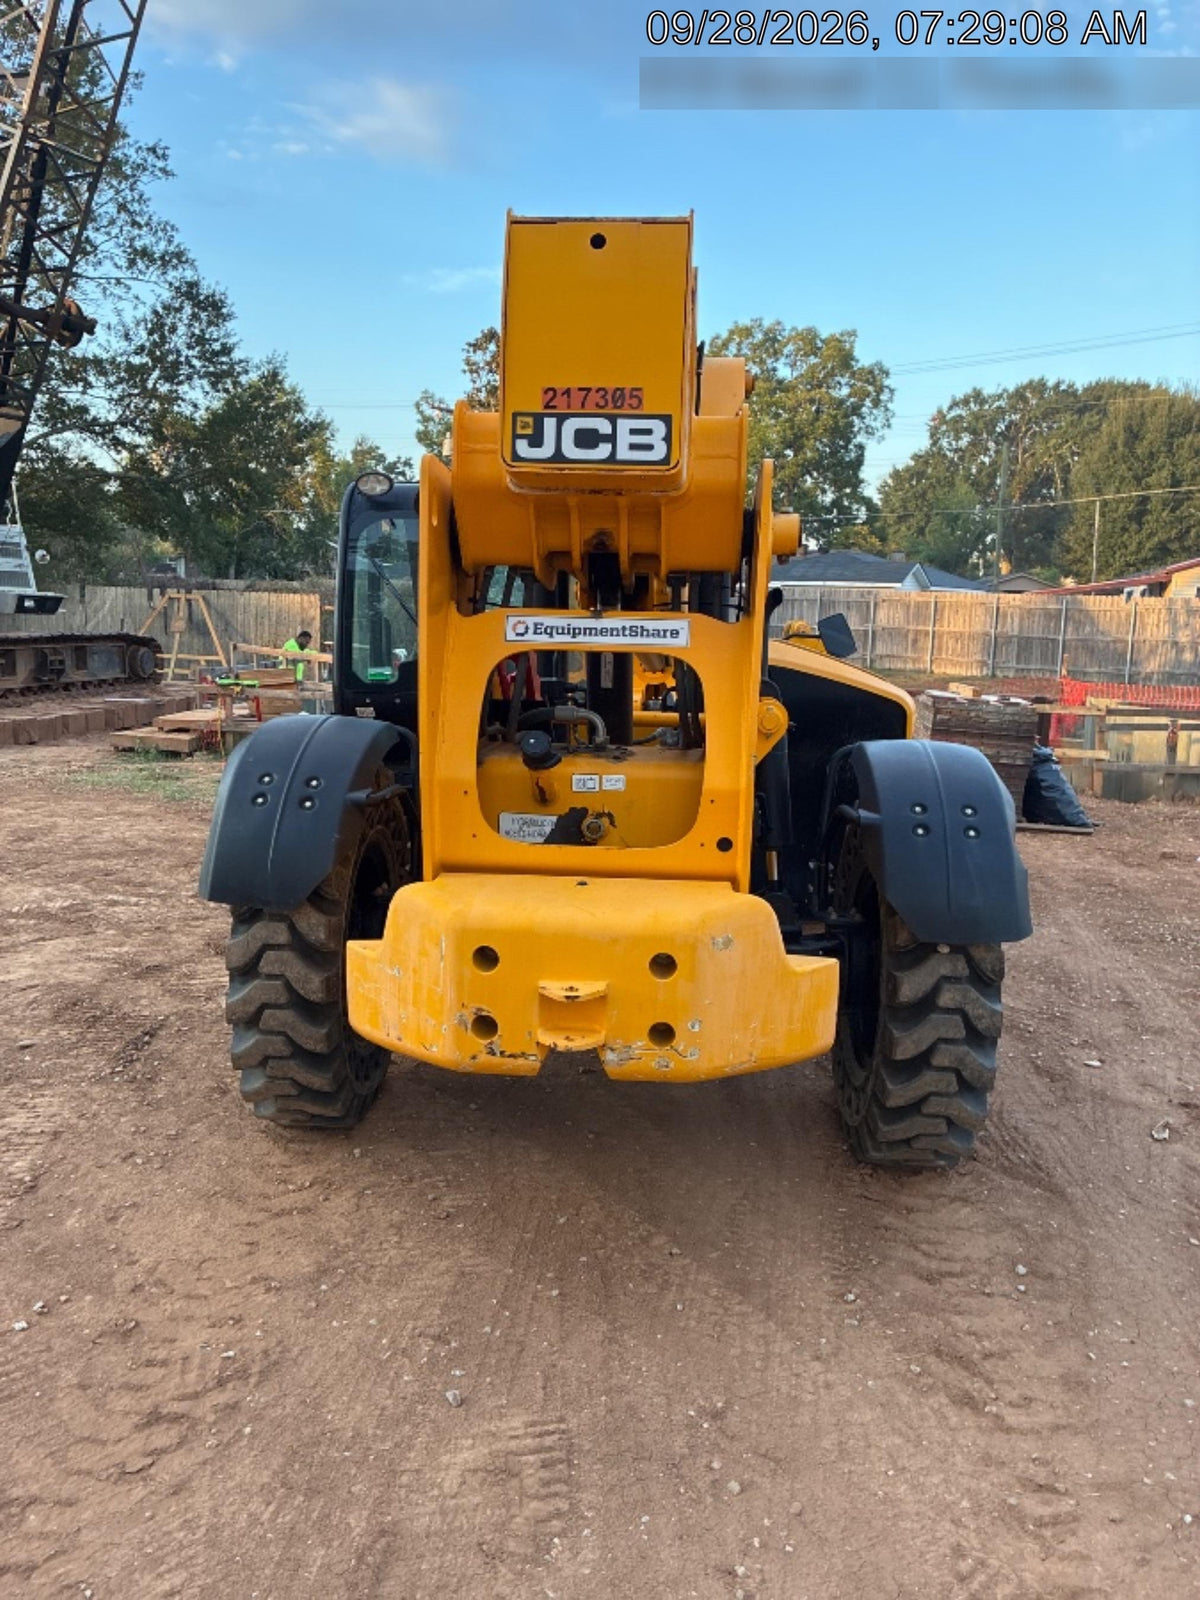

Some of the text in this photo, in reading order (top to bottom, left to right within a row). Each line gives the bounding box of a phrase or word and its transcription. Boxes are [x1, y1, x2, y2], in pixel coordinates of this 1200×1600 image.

[543, 387, 643, 410] 217305
[514, 416, 668, 462] JCB
[531, 621, 681, 640] EquipmentShare
